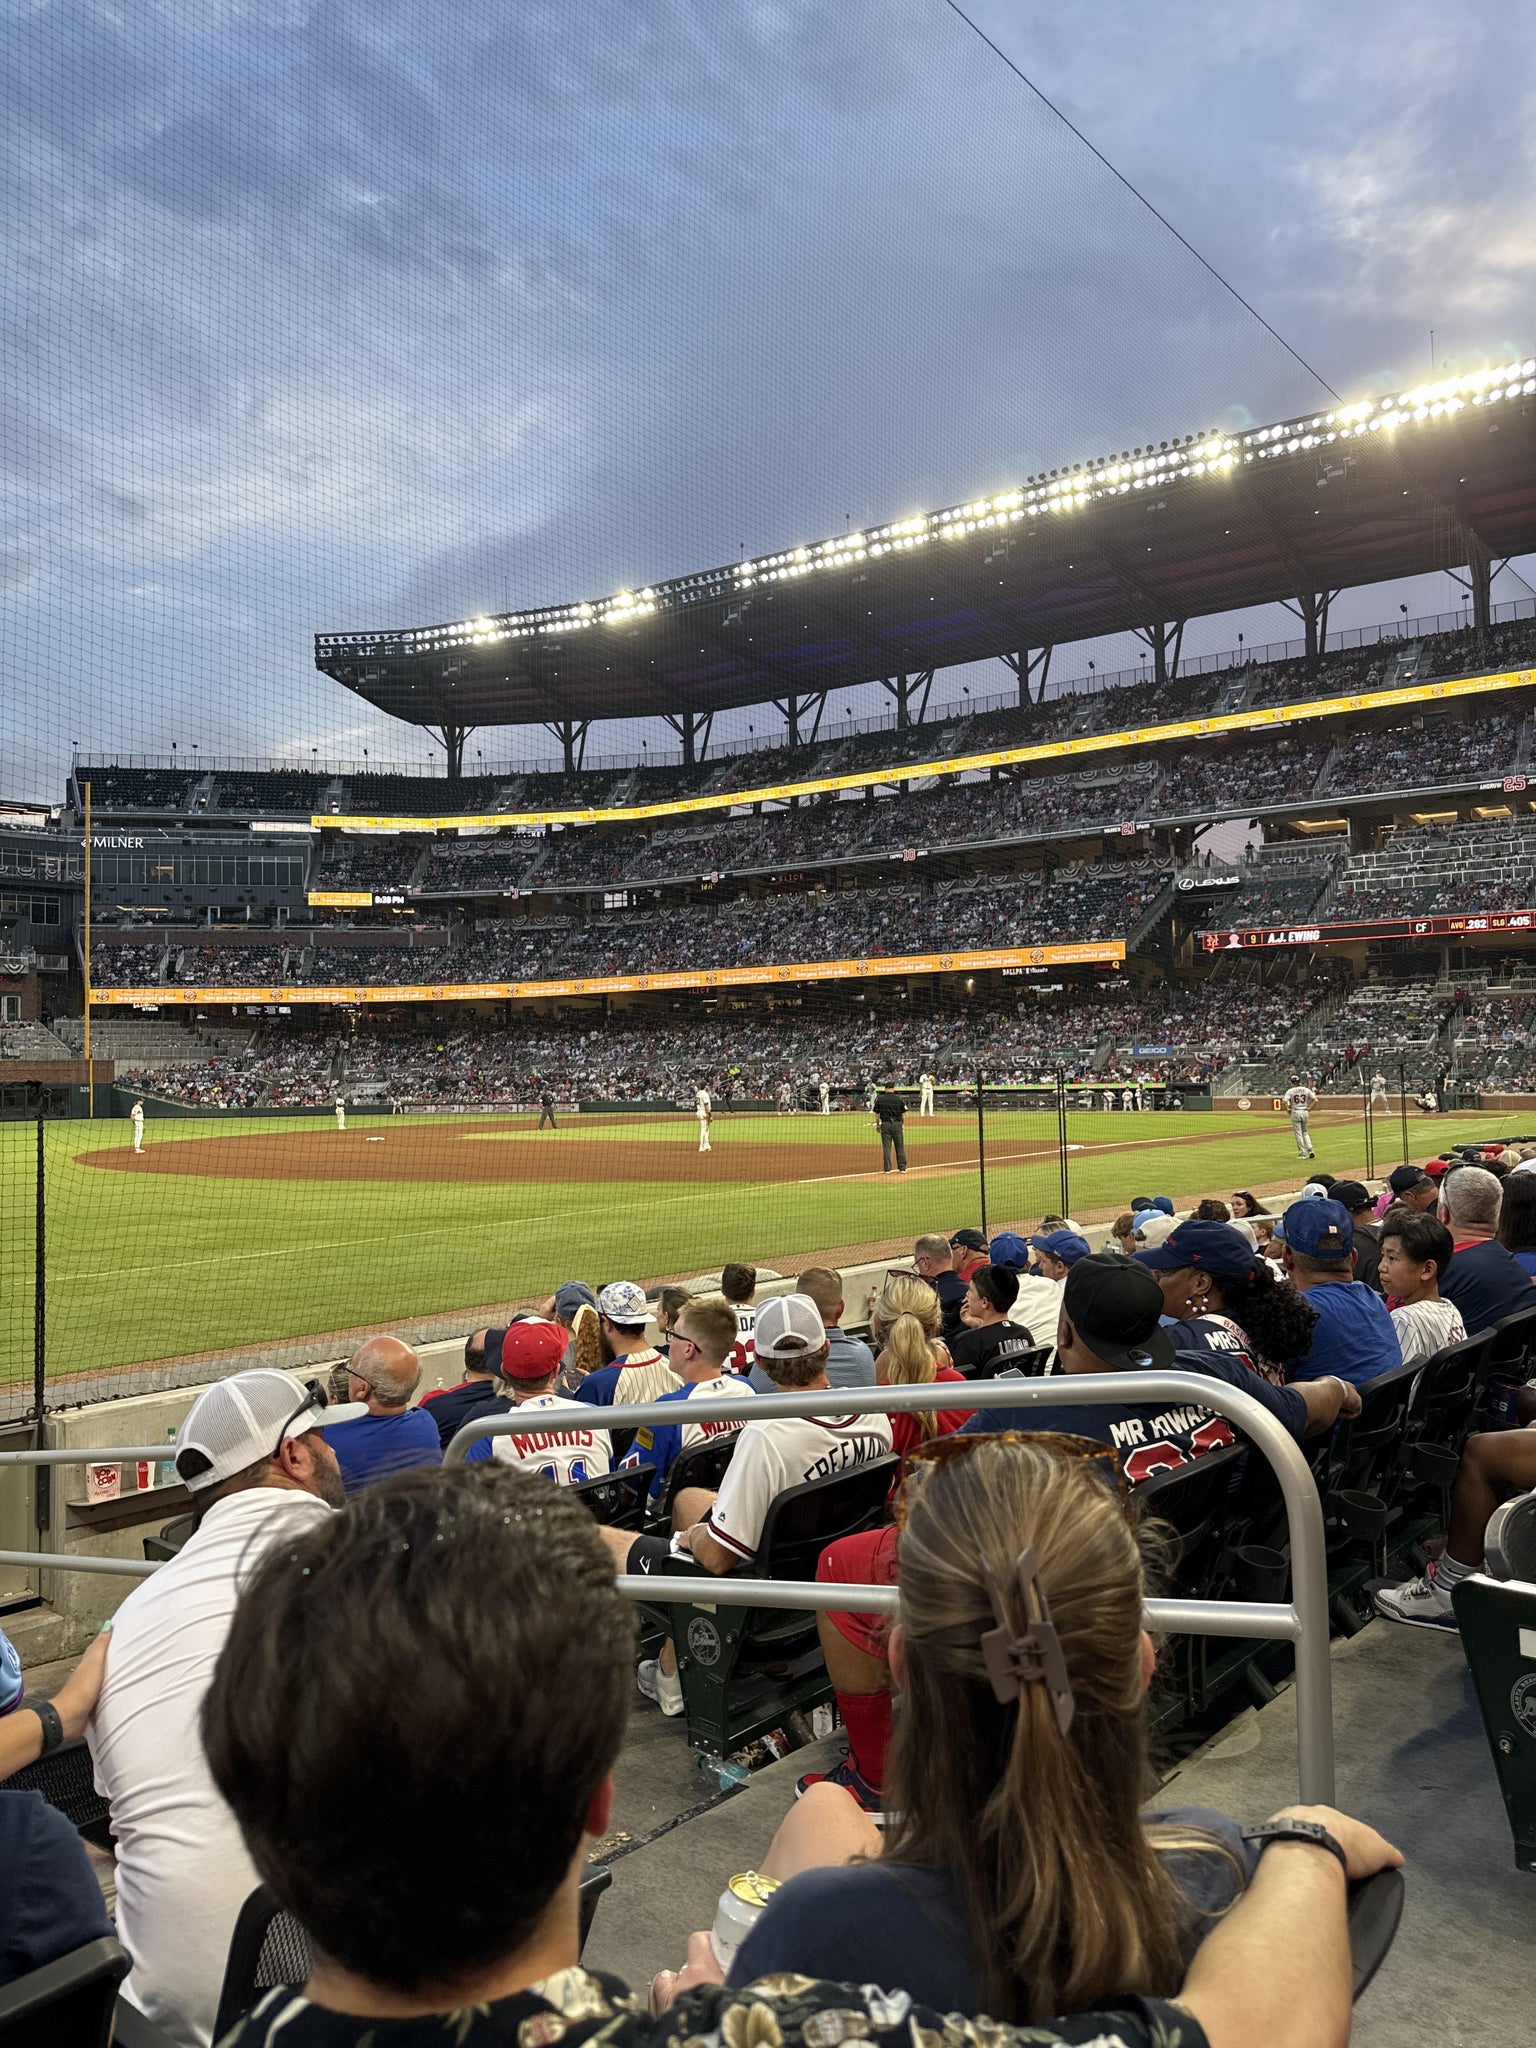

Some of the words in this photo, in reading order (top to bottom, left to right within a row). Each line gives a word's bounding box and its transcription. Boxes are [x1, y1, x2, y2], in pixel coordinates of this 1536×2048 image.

[1504, 775, 1526, 792] 25
[1122, 821, 1135, 836] 21
[94, 836, 144, 848] MILNER
[903, 848, 915, 861] 10
[1195, 876, 1240, 886] LEXUS
[1250, 935, 1256, 944] 9
[1268, 932, 1286, 944] A.J.
[1288, 930, 1320, 942] EWING
[1415, 923, 1427, 933] CF
[1492, 919, 1505, 927] SLG
[1507, 916, 1530, 926] .405
[1080, 952, 1098, 960] world
[1002, 967, 1030, 976] BALLPAK
[1294, 1094, 1306, 1104] 63
[1204, 1331, 1240, 1350] MRS
[1109, 1419, 1148, 1449] MR
[1149, 1404, 1223, 1438] HOWAR
[511, 1429, 592, 1459] MORRIS
[95, 1469, 110, 1479] POP
[98, 1473, 115, 1486] CORN
